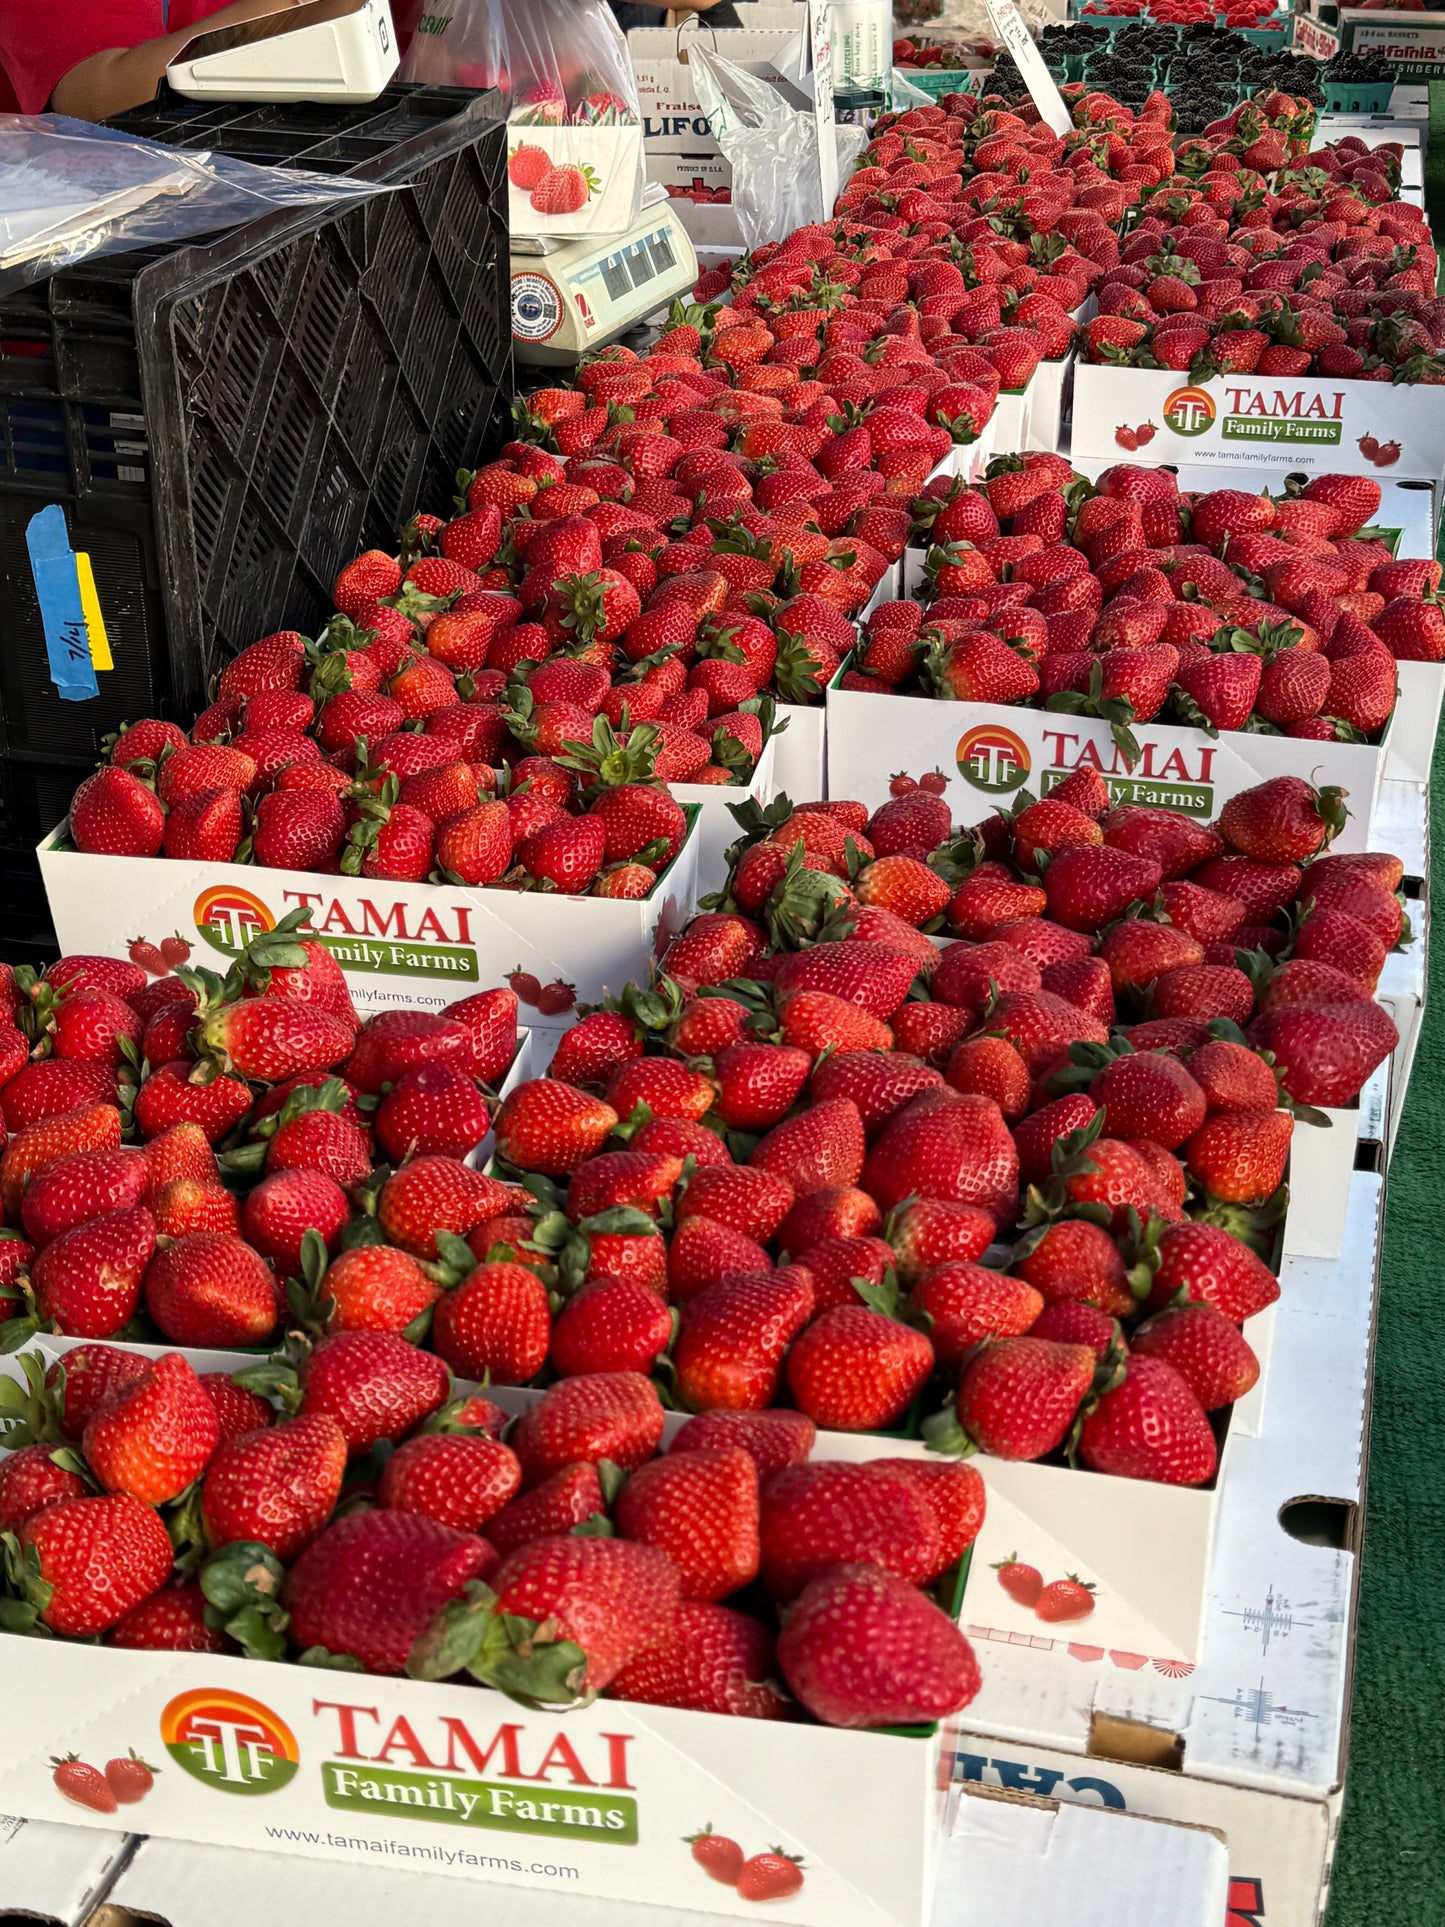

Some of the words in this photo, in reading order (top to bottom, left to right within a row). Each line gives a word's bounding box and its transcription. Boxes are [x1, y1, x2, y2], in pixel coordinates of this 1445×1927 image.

[1225, 387, 1346, 420] TAMAI
[1225, 419, 1283, 439] Family
[1285, 423, 1337, 439] Farms
[1194, 449, 1315, 465] www.tamaifamilyfarms.com
[1042, 730, 1218, 784] TAMAI
[1047, 774, 1127, 807] Fly
[1132, 784, 1206, 809] Farms
[283, 889, 476, 945] TAMAI
[328, 943, 385, 969] mily
[389, 946, 471, 973] Farms
[348, 987, 447, 1007] milyfarms.com
[312, 1698, 636, 1790] TAMAI
[332, 1767, 481, 1821] Family
[489, 1786, 627, 1831] Farms
[265, 1823, 580, 1879] www.tamaifamilyfarms.com
